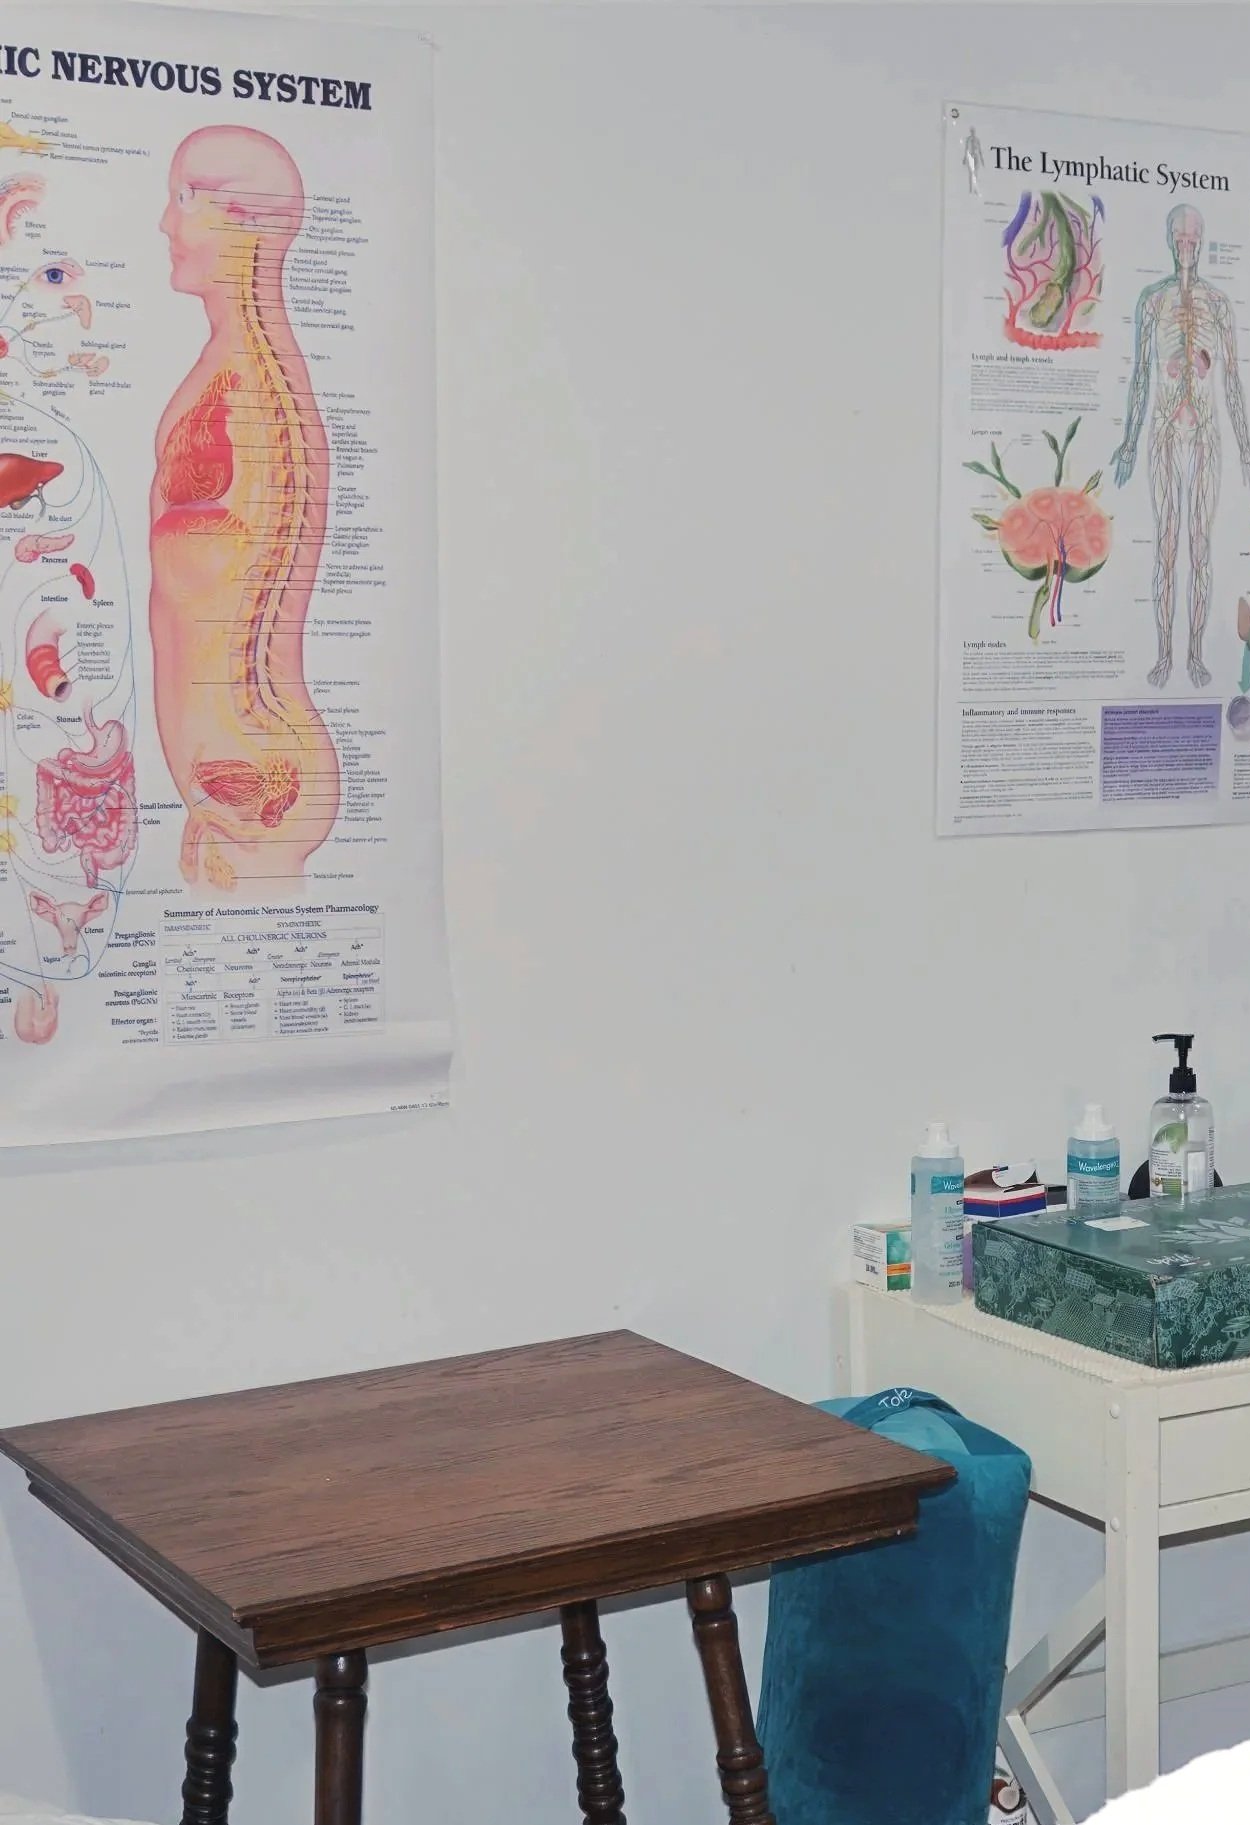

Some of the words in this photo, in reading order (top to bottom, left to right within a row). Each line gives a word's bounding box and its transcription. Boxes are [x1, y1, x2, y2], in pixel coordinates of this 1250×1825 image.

[0, 45, 41, 78] IC
[51, 50, 222, 96] NERVOUS
[233, 69, 372, 111] SYSTEM
[990, 146, 1032, 173] The
[1040, 151, 1149, 185] Lymphatic
[1157, 163, 1230, 193] System
[32, 450, 48, 458] Liver
[92, 600, 114, 608] Spleen
[963, 641, 986, 650] Lymph
[962, 709, 1005, 718] Inflammatory
[164, 909, 203, 919] Summary
[205, 908, 213, 916] of
[216, 907, 259, 916] Autonomic
[261, 906, 294, 915] Nervous
[296, 905, 324, 914] System
[325, 904, 379, 914] Pharmacology
[115, 931, 156, 940] Preganglionic
[221, 934, 235, 942] ALL
[237, 933, 289, 941] CHOLINERGIC
[132, 960, 156, 968] Ganglia
[114, 990, 157, 998] Postganglionic
[223, 992, 255, 1000] Receptors
